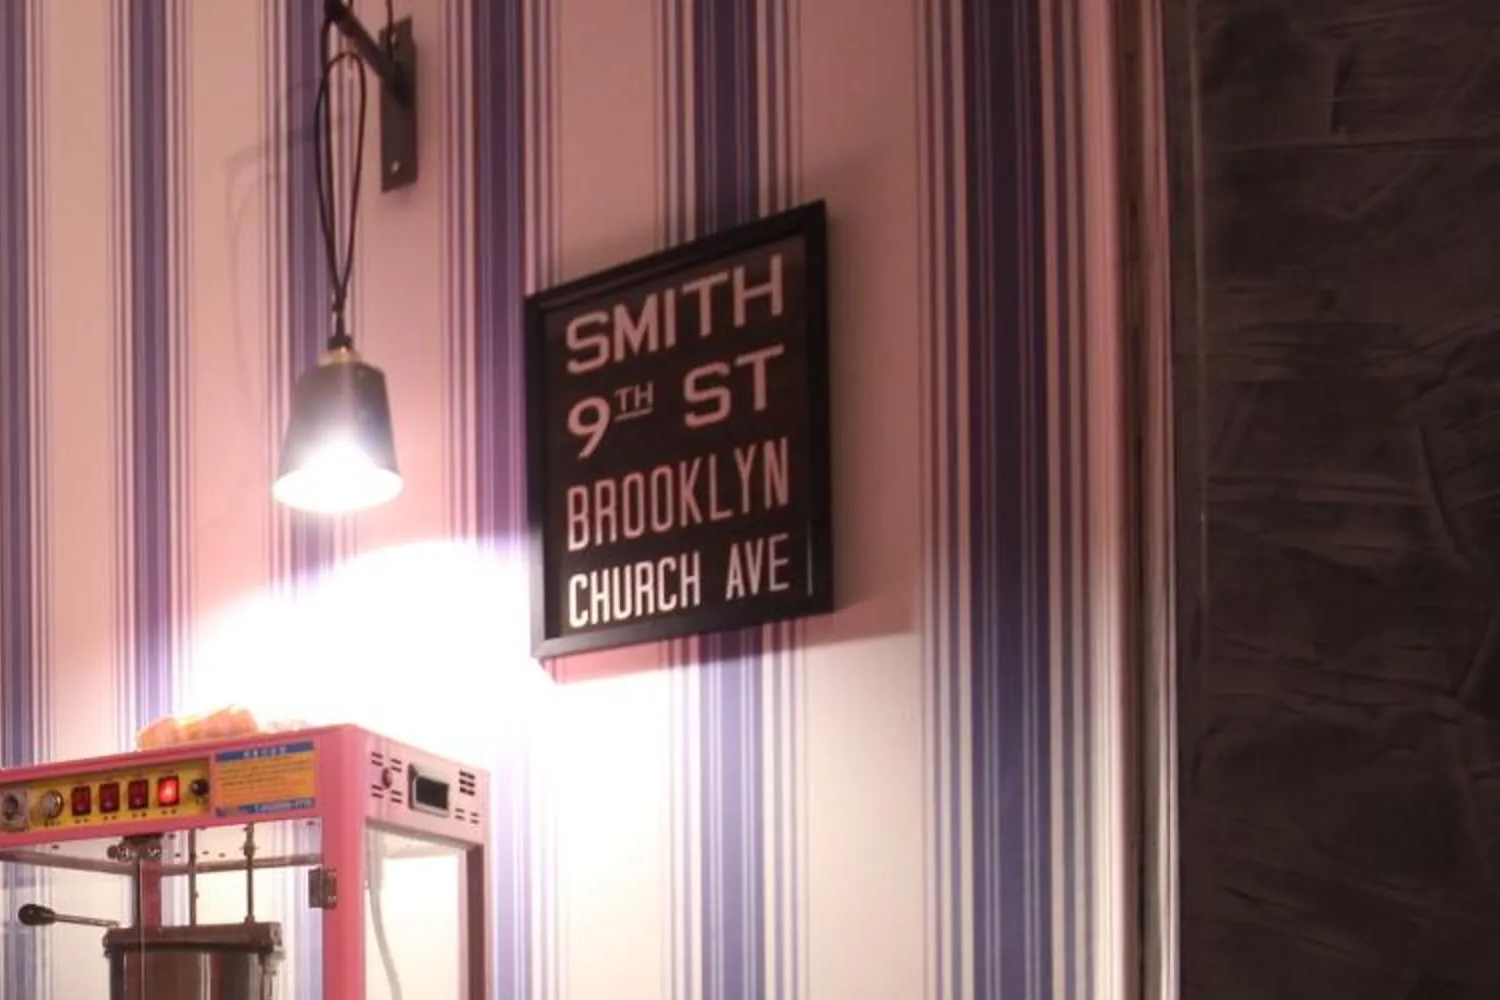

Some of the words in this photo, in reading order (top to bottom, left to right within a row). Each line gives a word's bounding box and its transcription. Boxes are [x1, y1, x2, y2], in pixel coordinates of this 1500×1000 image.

[566, 254, 783, 375] SMITH
[683, 344, 785, 429] ST
[567, 437, 789, 553] BROOKLYN
[567, 550, 701, 629] CHURCH
[725, 533, 789, 602] AVE
